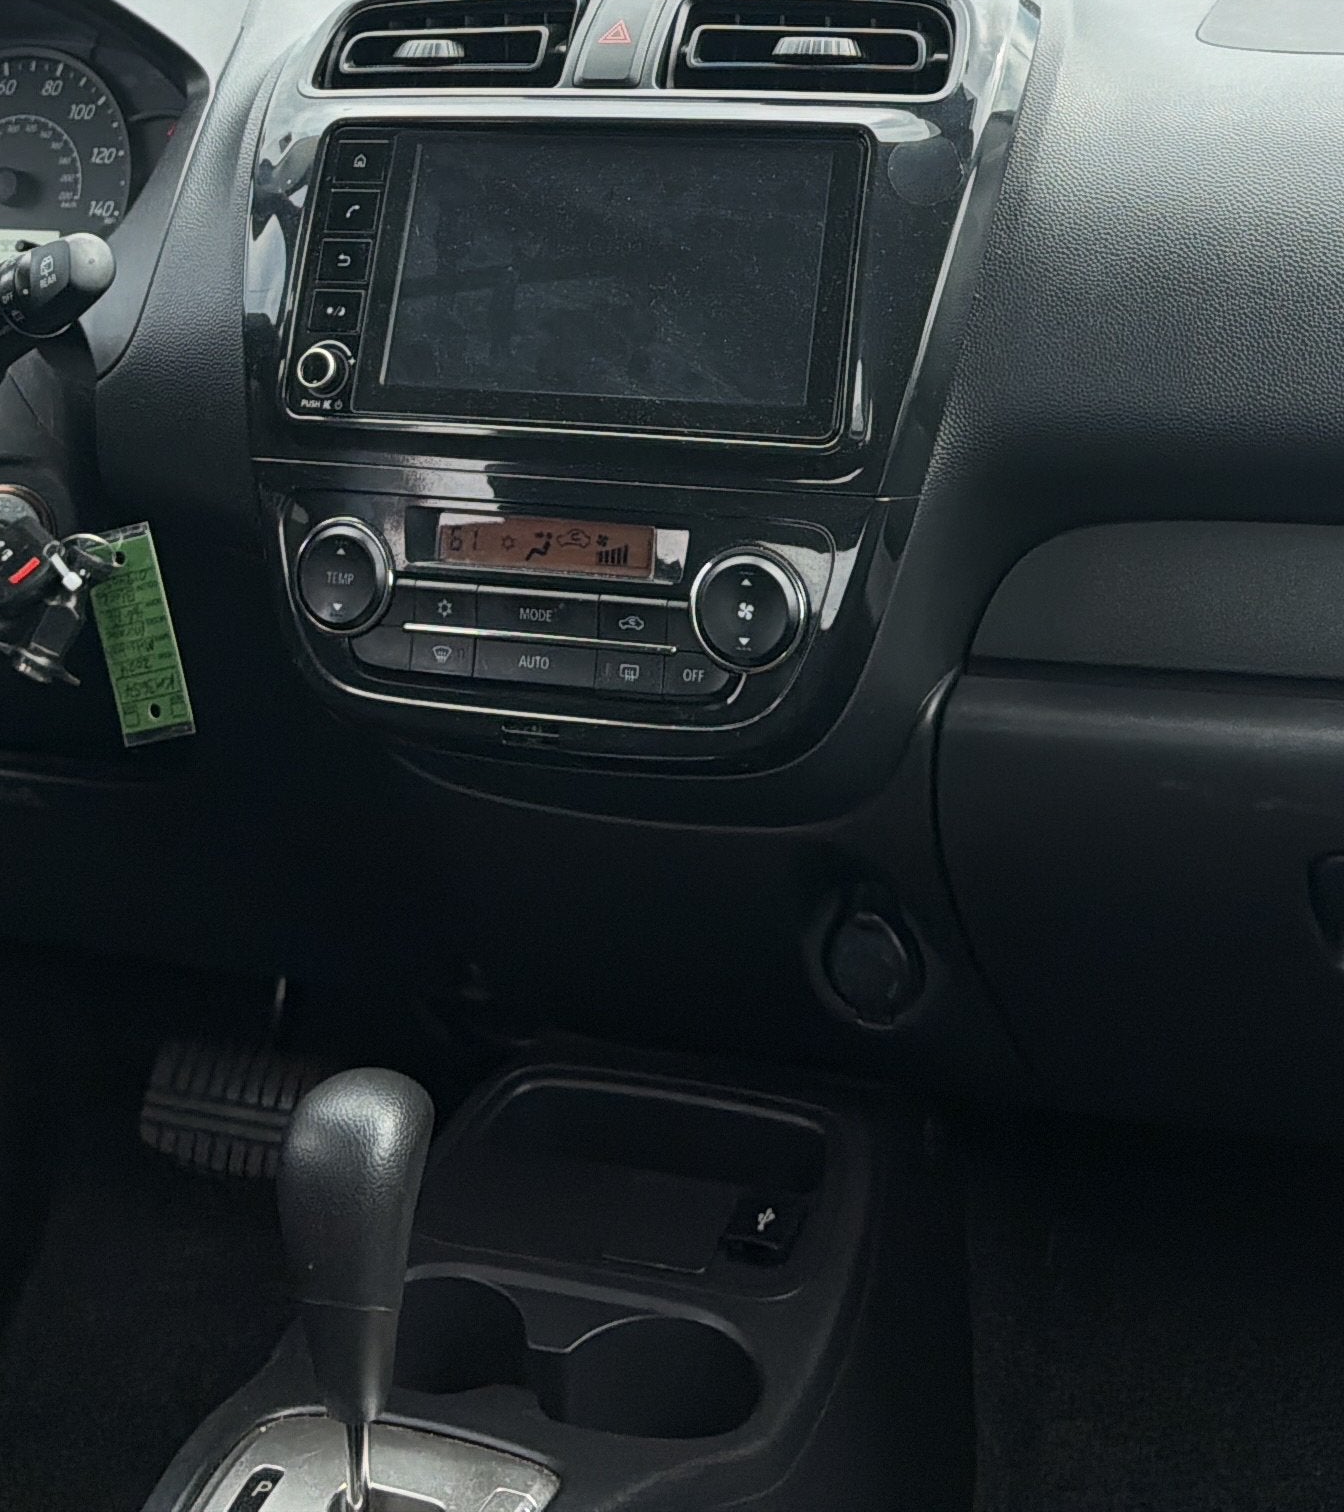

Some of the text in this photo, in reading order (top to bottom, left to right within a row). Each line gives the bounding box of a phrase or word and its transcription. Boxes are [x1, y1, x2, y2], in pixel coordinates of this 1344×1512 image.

[41, 79, 64, 97] 80
[67, 103, 96, 120] 100
[90, 146, 116, 165] 120
[88, 199, 115, 217] 140
[301, 398, 322, 409] PUSH
[326, 571, 355, 586] TEMP
[519, 607, 553, 623] MODE
[518, 654, 550, 670] AUTO
[682, 668, 705, 682] OFF
[250, 1480, 273, 1497] P
